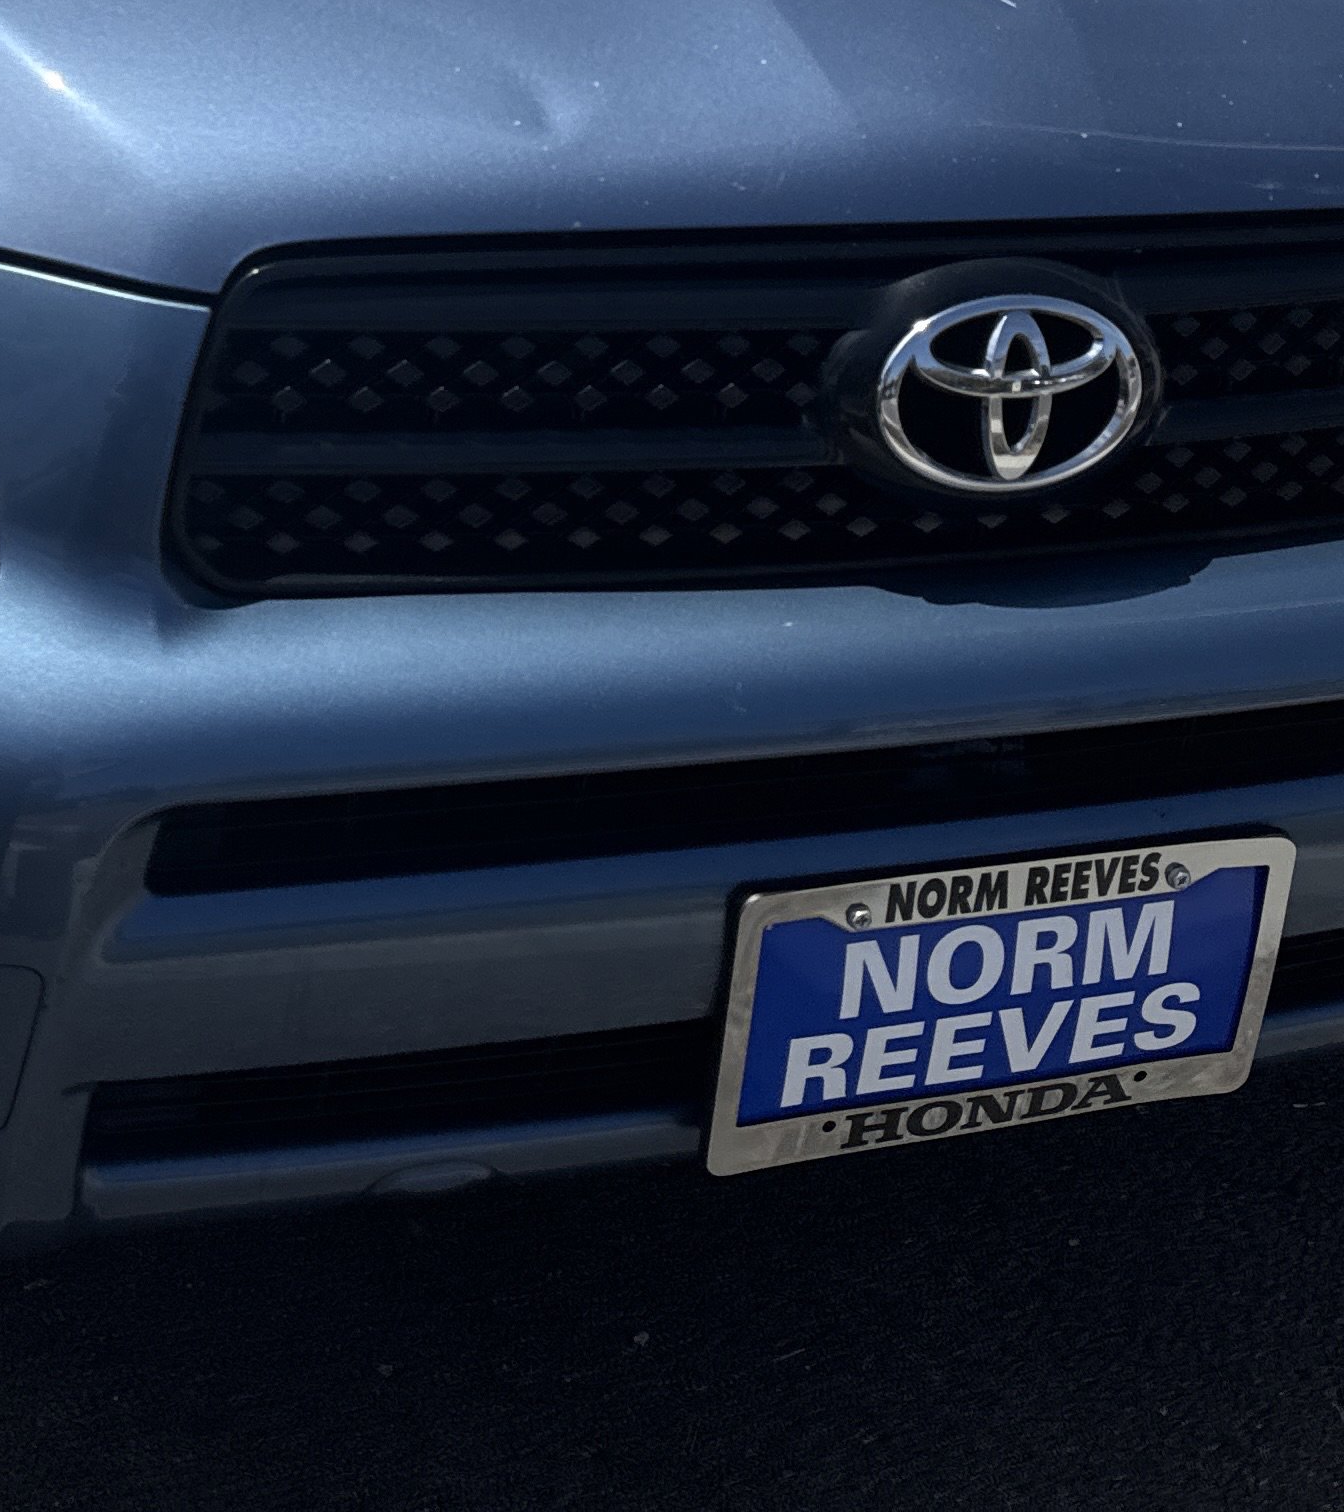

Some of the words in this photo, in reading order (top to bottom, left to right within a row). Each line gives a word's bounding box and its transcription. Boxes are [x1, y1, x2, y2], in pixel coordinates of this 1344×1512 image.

[885, 870, 1009, 923] NORM
[1023, 852, 1162, 907] REEVES
[838, 899, 1175, 1021] NORM
[780, 981, 1201, 1109] REEVES
[840, 1072, 1132, 1151] HONDA
